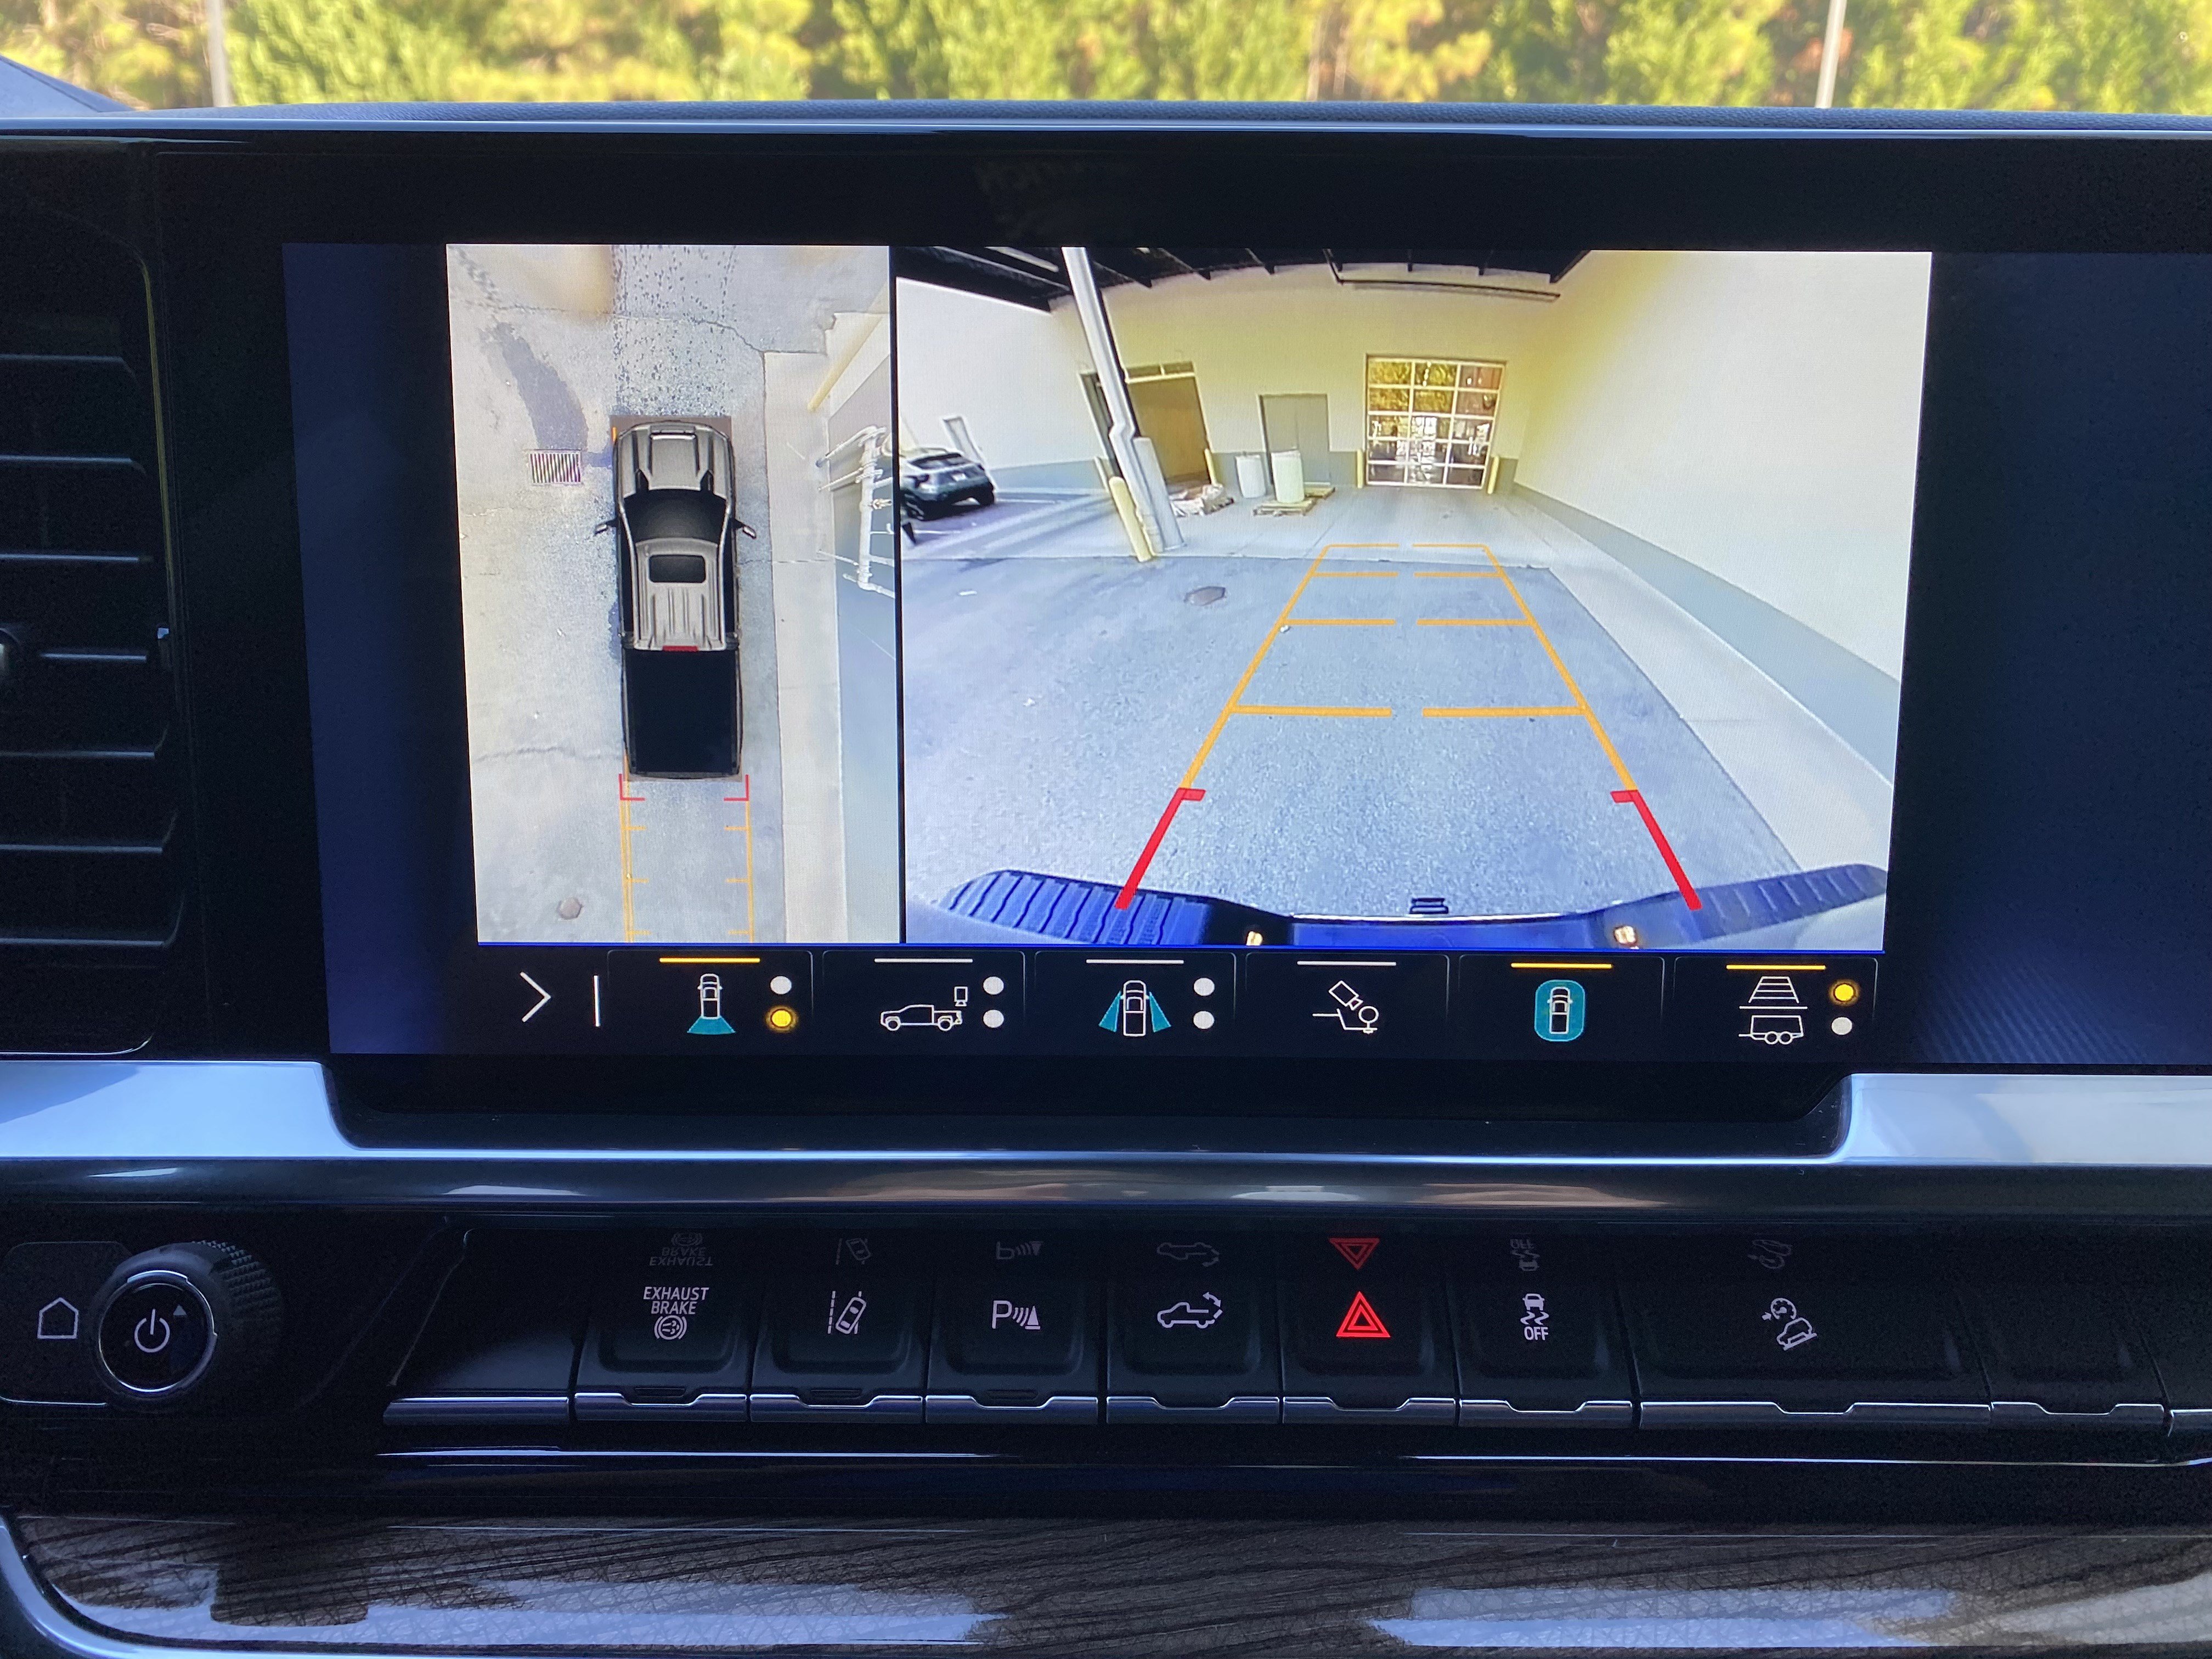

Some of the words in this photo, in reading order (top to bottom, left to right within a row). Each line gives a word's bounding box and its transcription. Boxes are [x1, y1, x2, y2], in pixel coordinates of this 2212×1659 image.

[643, 1286, 709, 1300] EXHAUST
[651, 1301, 697, 1314] BRAKE
[1524, 1326, 1549, 1341] OFF
